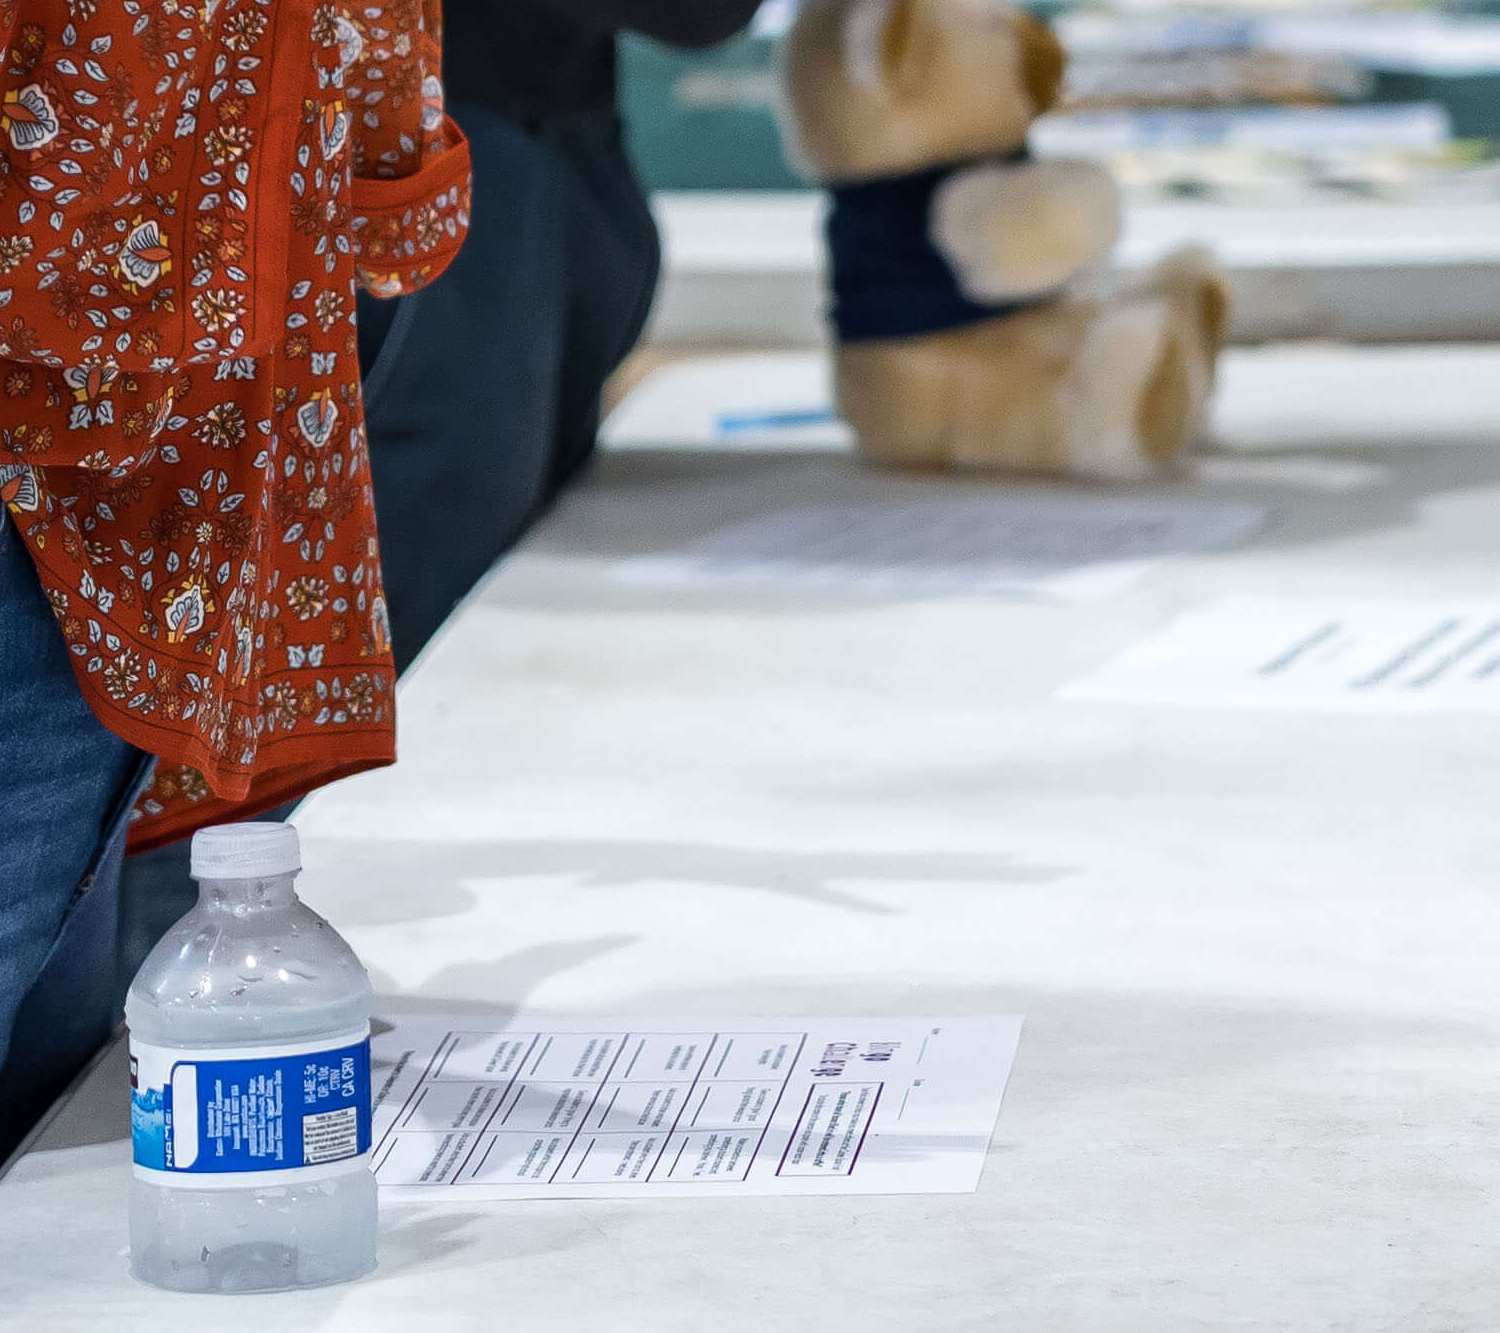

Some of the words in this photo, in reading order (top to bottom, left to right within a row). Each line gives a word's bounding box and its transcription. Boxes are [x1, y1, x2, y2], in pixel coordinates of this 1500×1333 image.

[860, 1041, 902, 1062] Bingo
[341, 1057, 354, 1080] CRV
[341, 1080, 355, 1097] CA
